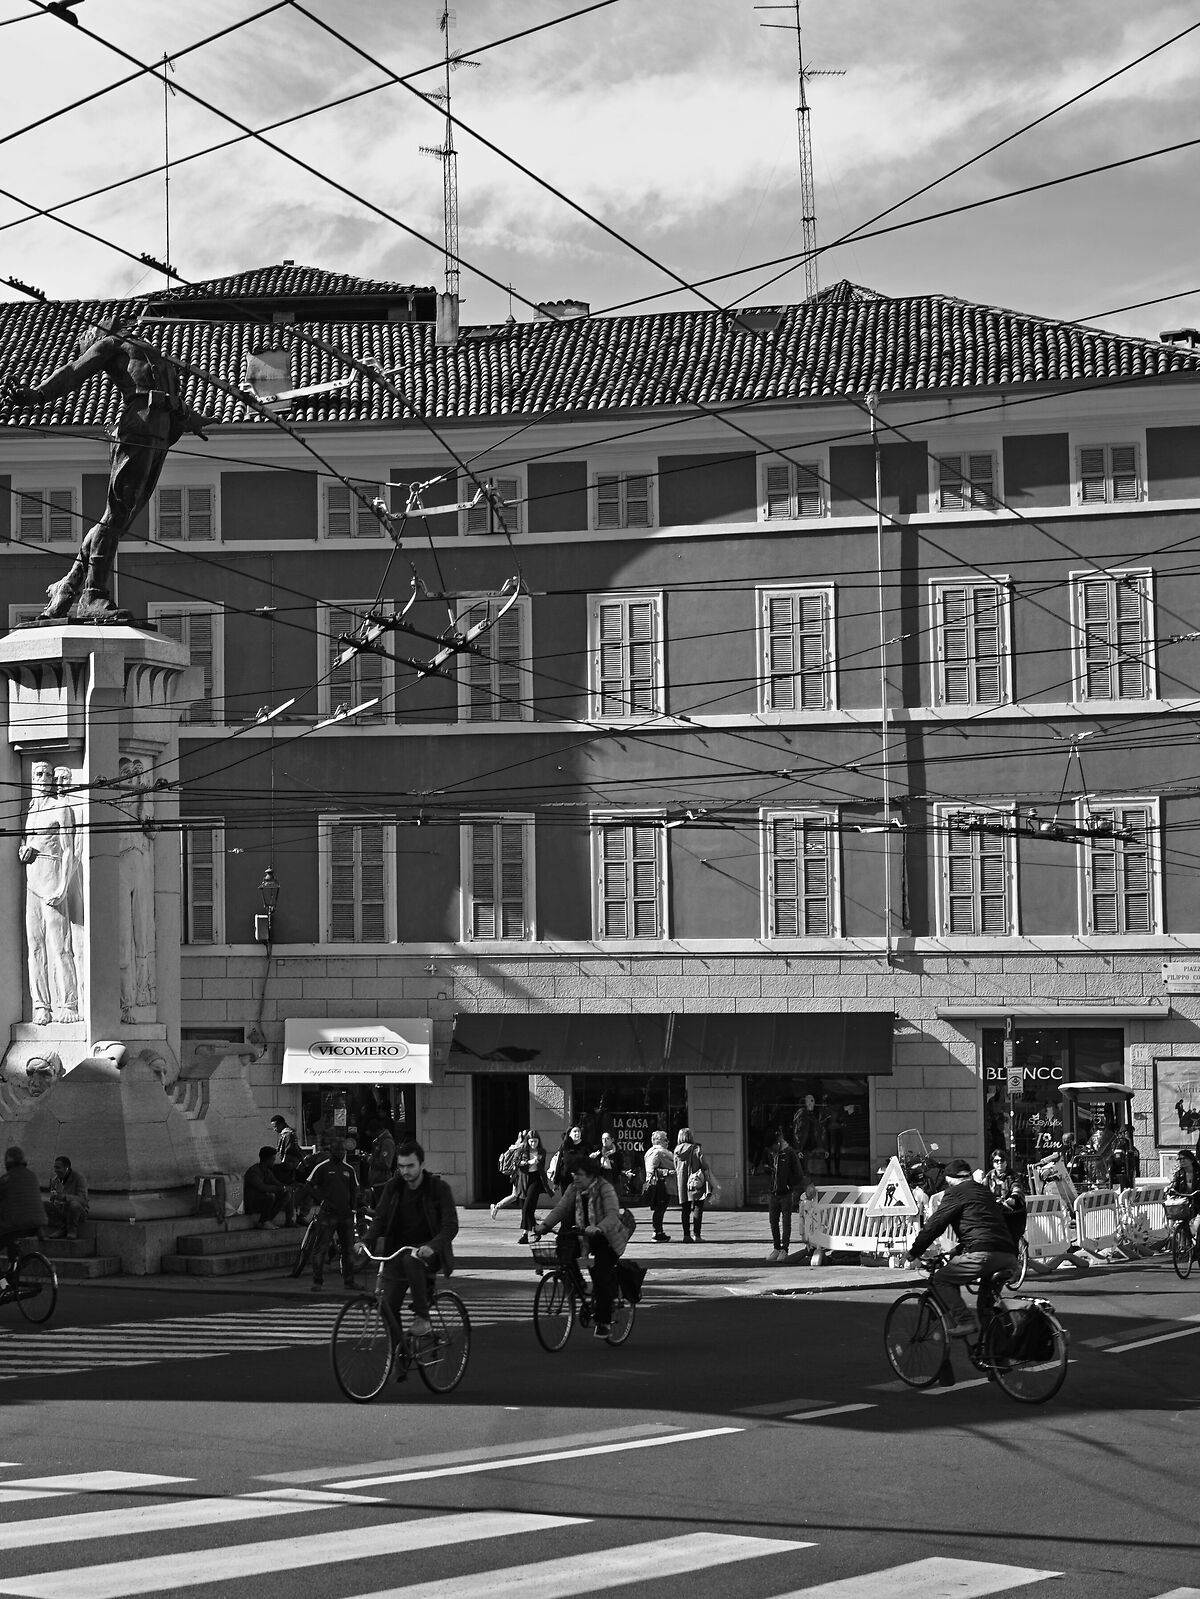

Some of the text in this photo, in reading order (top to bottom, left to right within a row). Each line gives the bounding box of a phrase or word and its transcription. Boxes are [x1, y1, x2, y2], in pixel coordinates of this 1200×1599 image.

[318, 1046, 399, 1056] VICOMERO
[986, 1066, 1063, 1080] BLNCO
[613, 1118, 648, 1128] LA CASA
[618, 1130, 644, 1140] DELLO
[617, 1141, 645, 1152] STOCK
